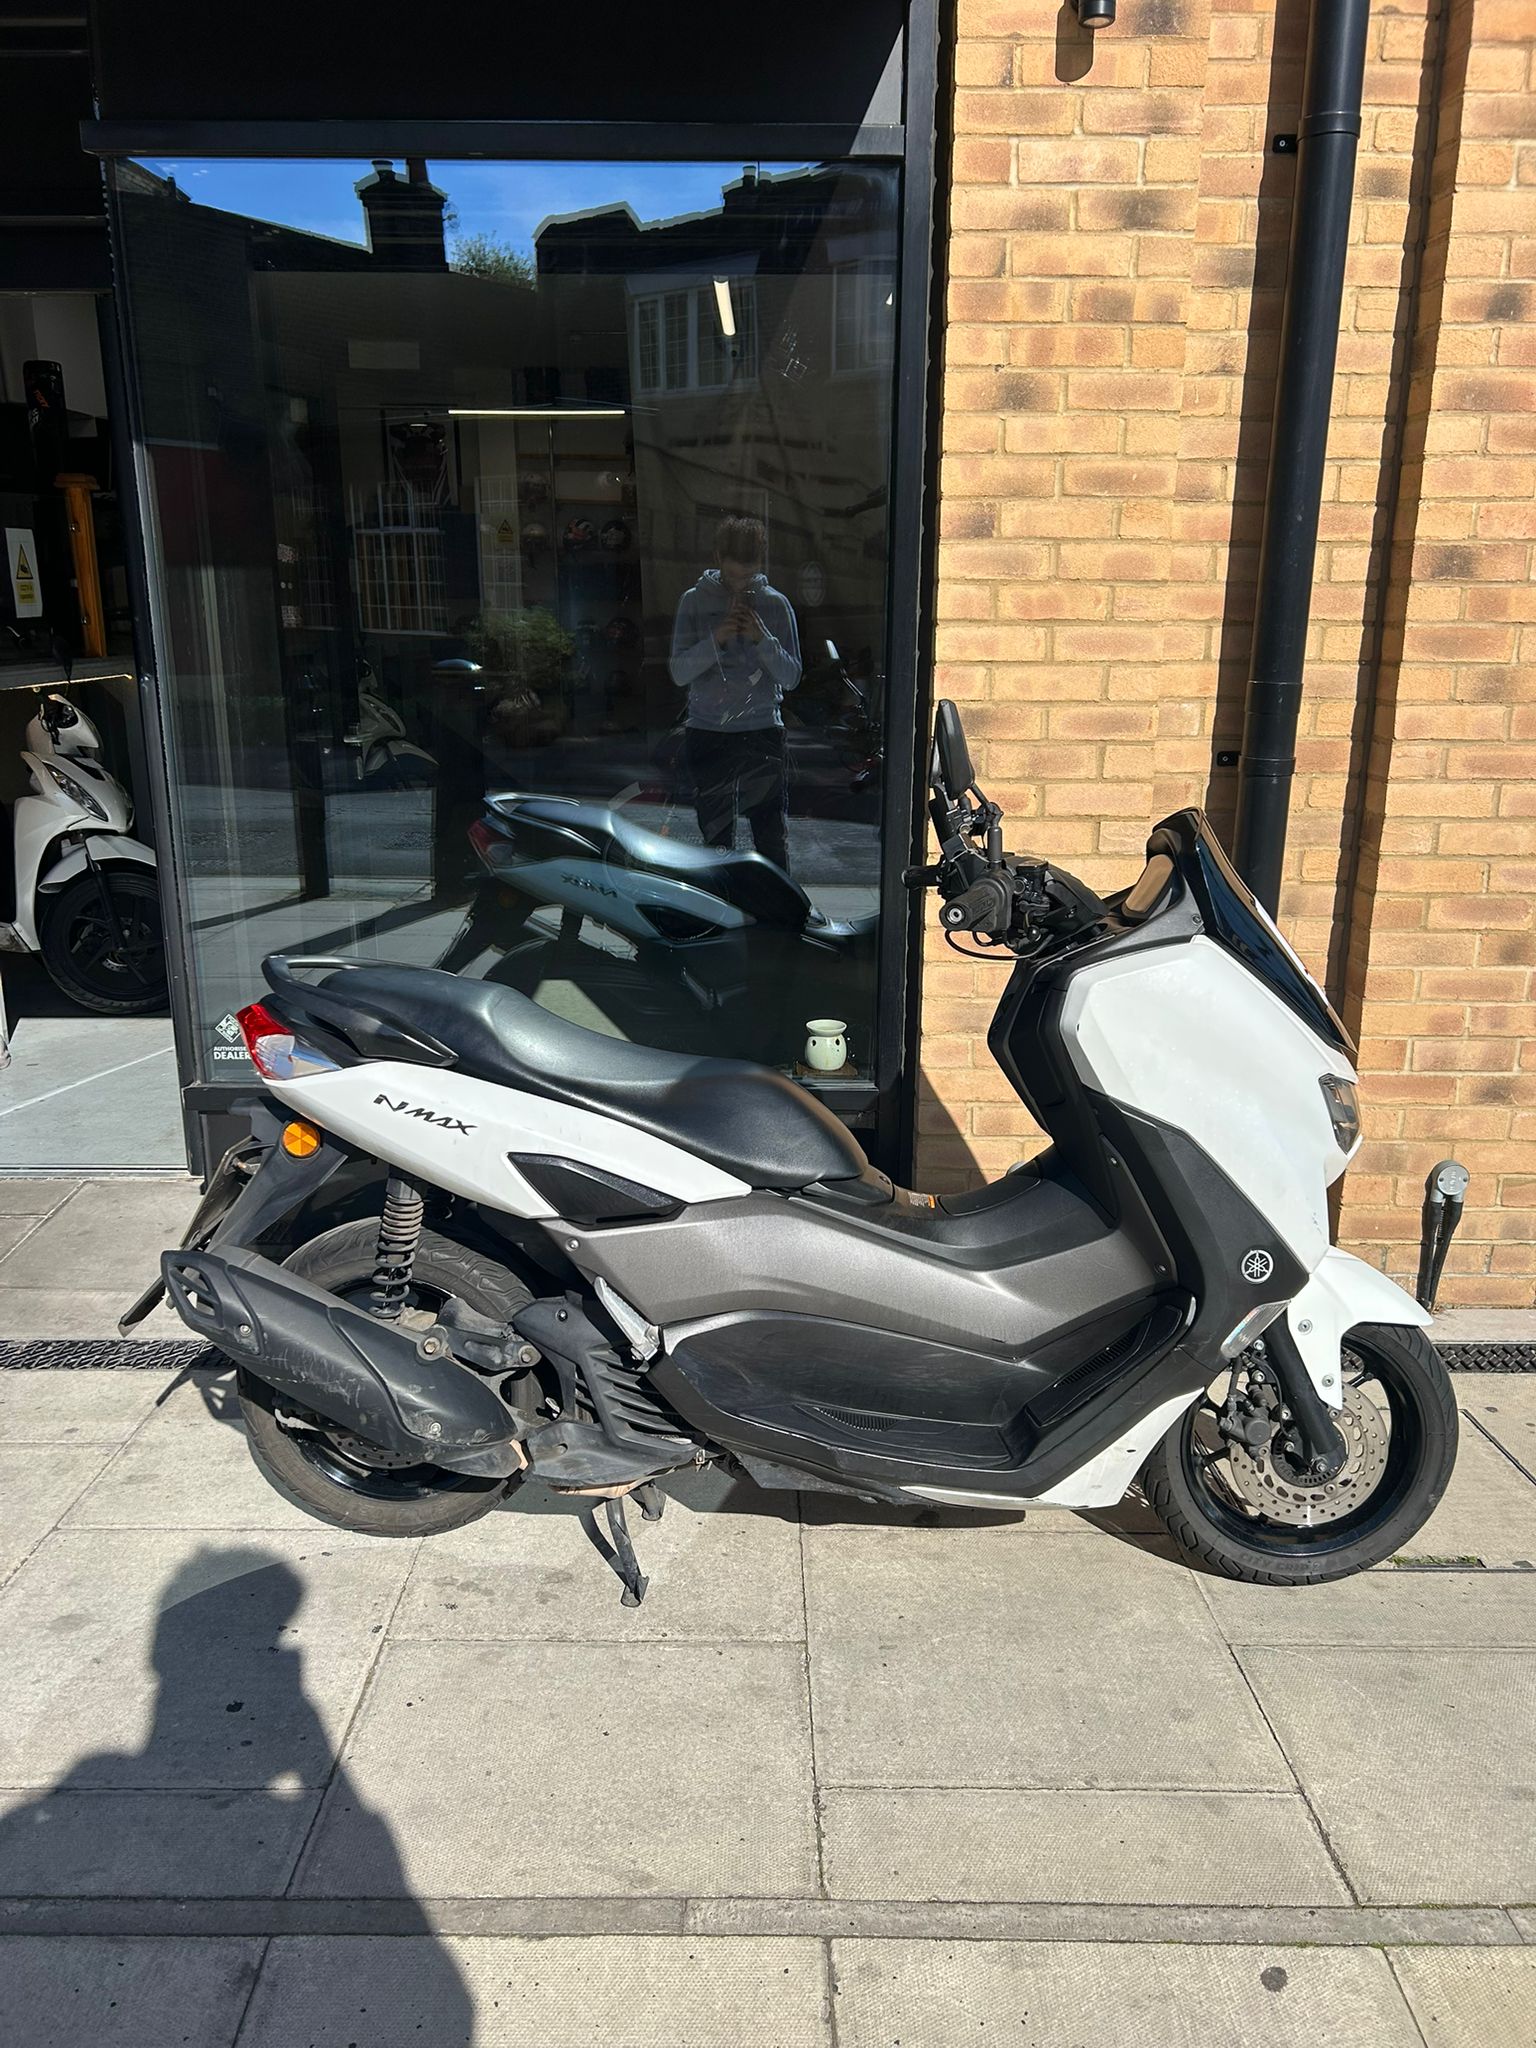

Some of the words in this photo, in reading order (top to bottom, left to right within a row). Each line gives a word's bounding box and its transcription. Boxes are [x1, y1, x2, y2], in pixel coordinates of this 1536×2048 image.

[213, 1051, 252, 1060] DEALER
[373, 1093, 478, 1136] NMAX
[1241, 1554, 1272, 1567] CITY
